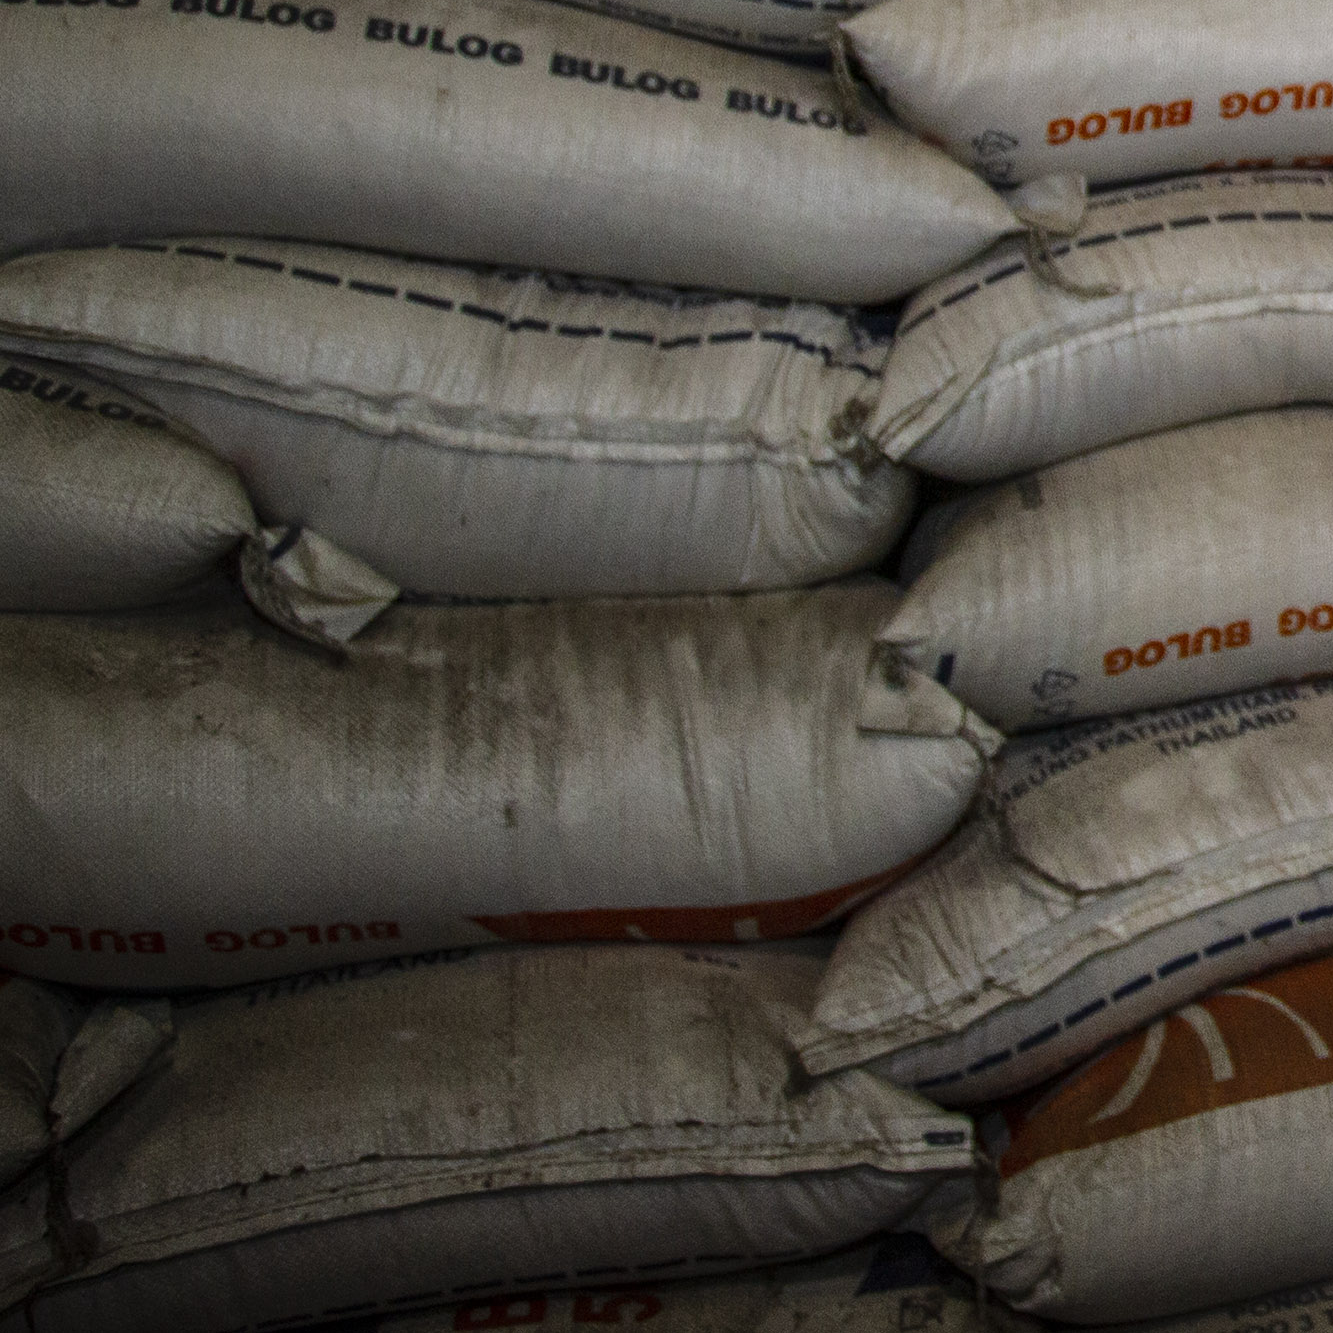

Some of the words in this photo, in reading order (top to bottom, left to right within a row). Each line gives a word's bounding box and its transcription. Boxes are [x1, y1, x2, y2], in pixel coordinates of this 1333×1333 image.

[364, 16, 525, 68] BULOG
[548, 50, 702, 103] BULOG
[727, 89, 868, 137] BULOG
[1045, 97, 1195, 148] BULOG
[1103, 619, 1253, 677] BULOG
[0, 923, 167, 955] BULO
[205, 920, 401, 953] BULOG
